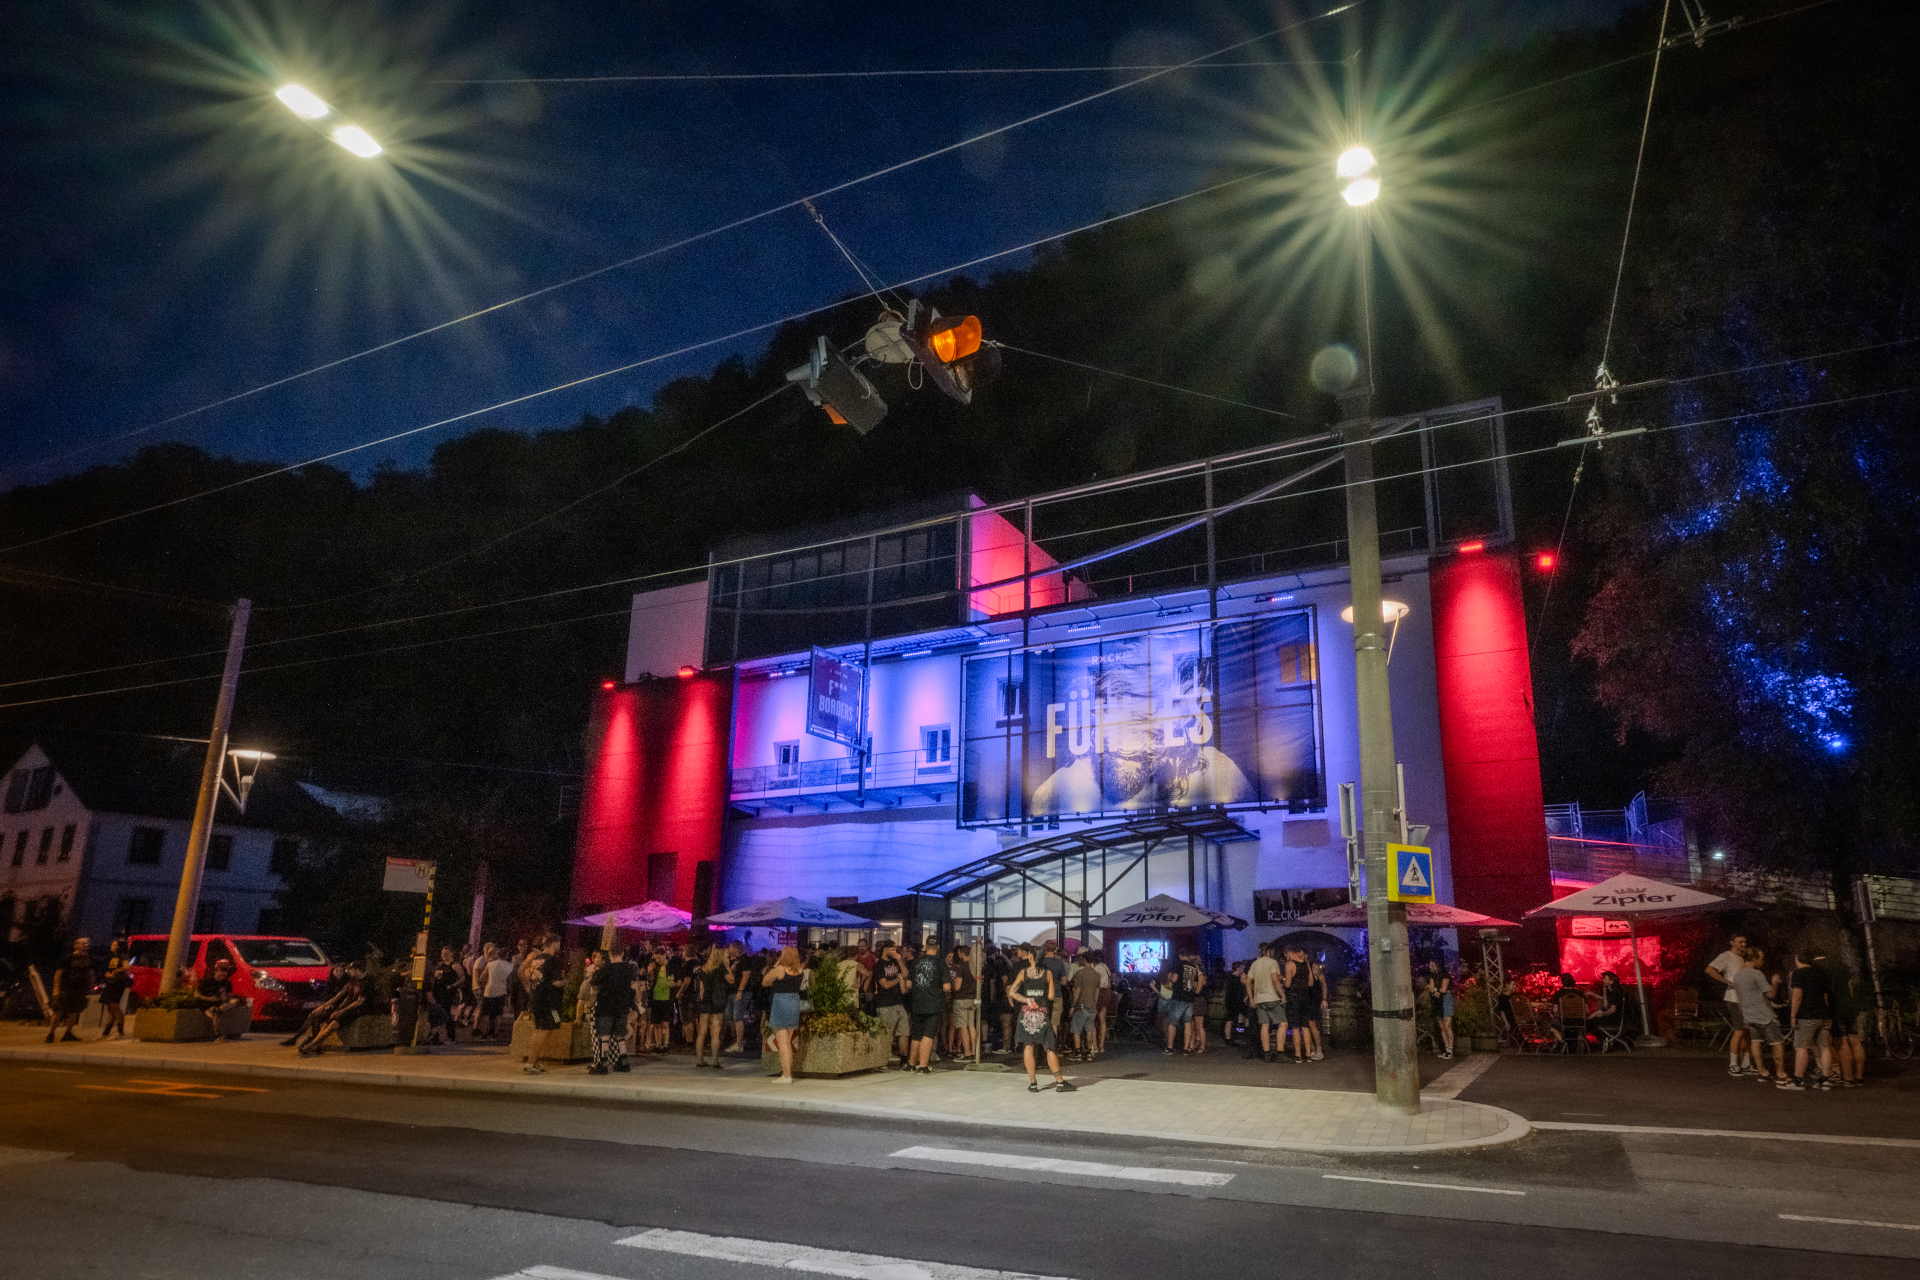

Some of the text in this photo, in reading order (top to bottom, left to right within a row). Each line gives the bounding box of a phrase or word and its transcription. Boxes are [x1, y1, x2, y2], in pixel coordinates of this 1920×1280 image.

[819, 694, 854, 722] BORDERS
[1592, 893, 1677, 907] Zipfer
[1120, 912, 1186, 924] Zipfer
